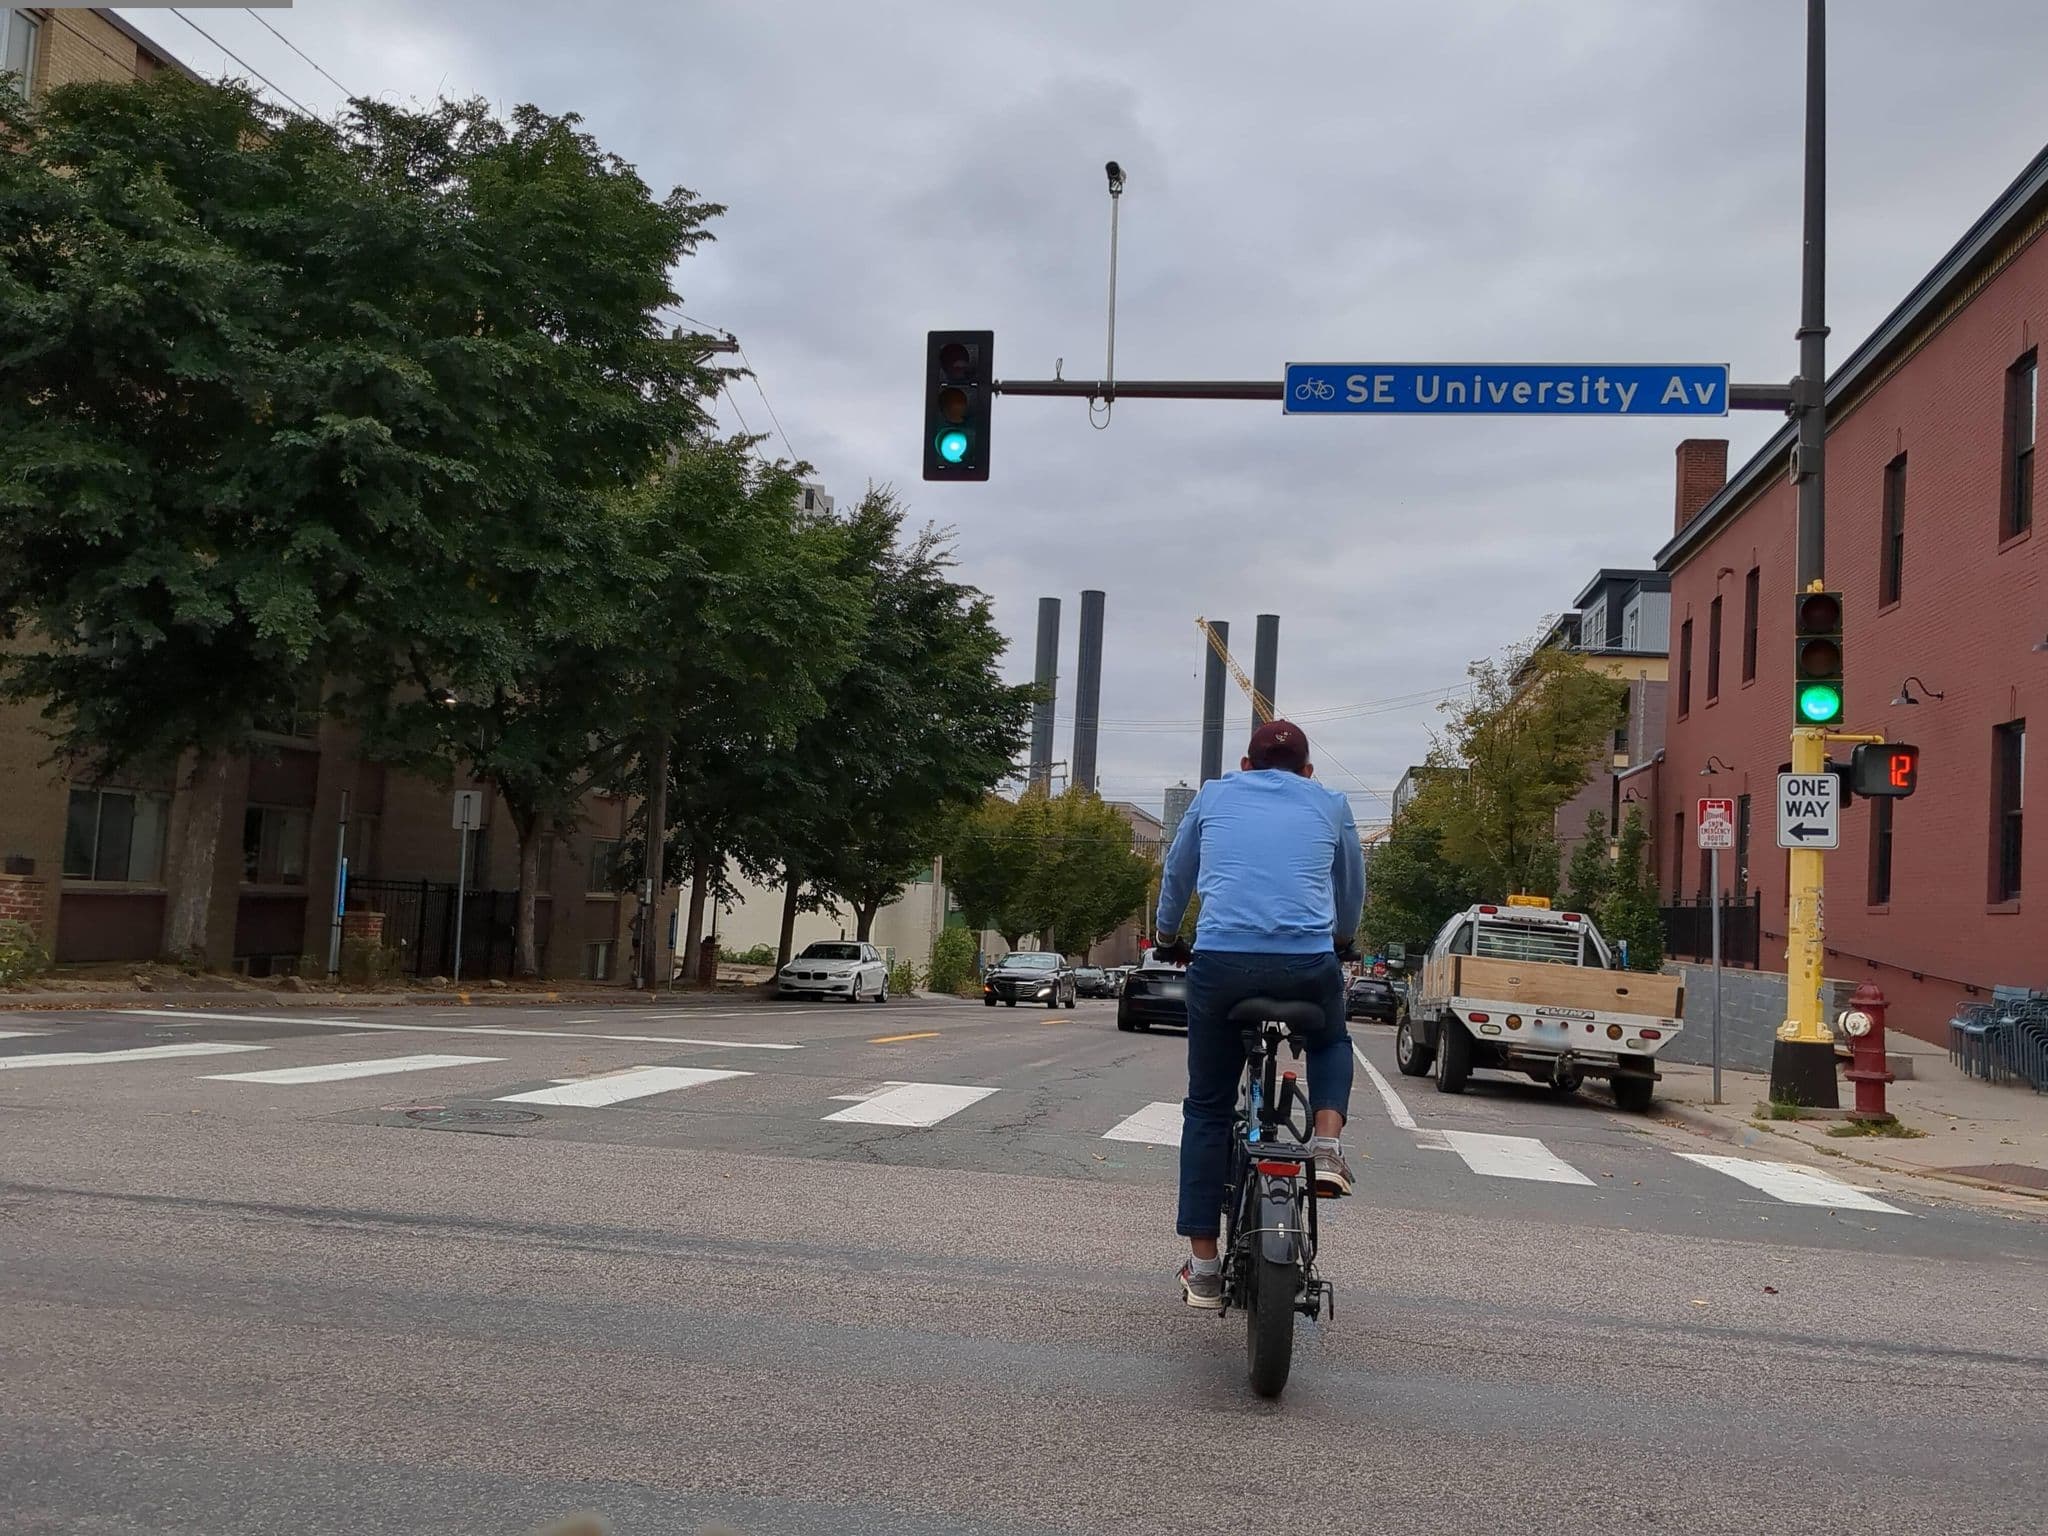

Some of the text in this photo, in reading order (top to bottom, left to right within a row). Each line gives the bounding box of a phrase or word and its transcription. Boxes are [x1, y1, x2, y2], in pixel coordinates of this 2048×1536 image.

[1346, 374, 1716, 412] SE University Av
[1890, 755, 1911, 786] 12
[1787, 779, 1830, 797] ONE
[1785, 801, 1830, 818] WAY
